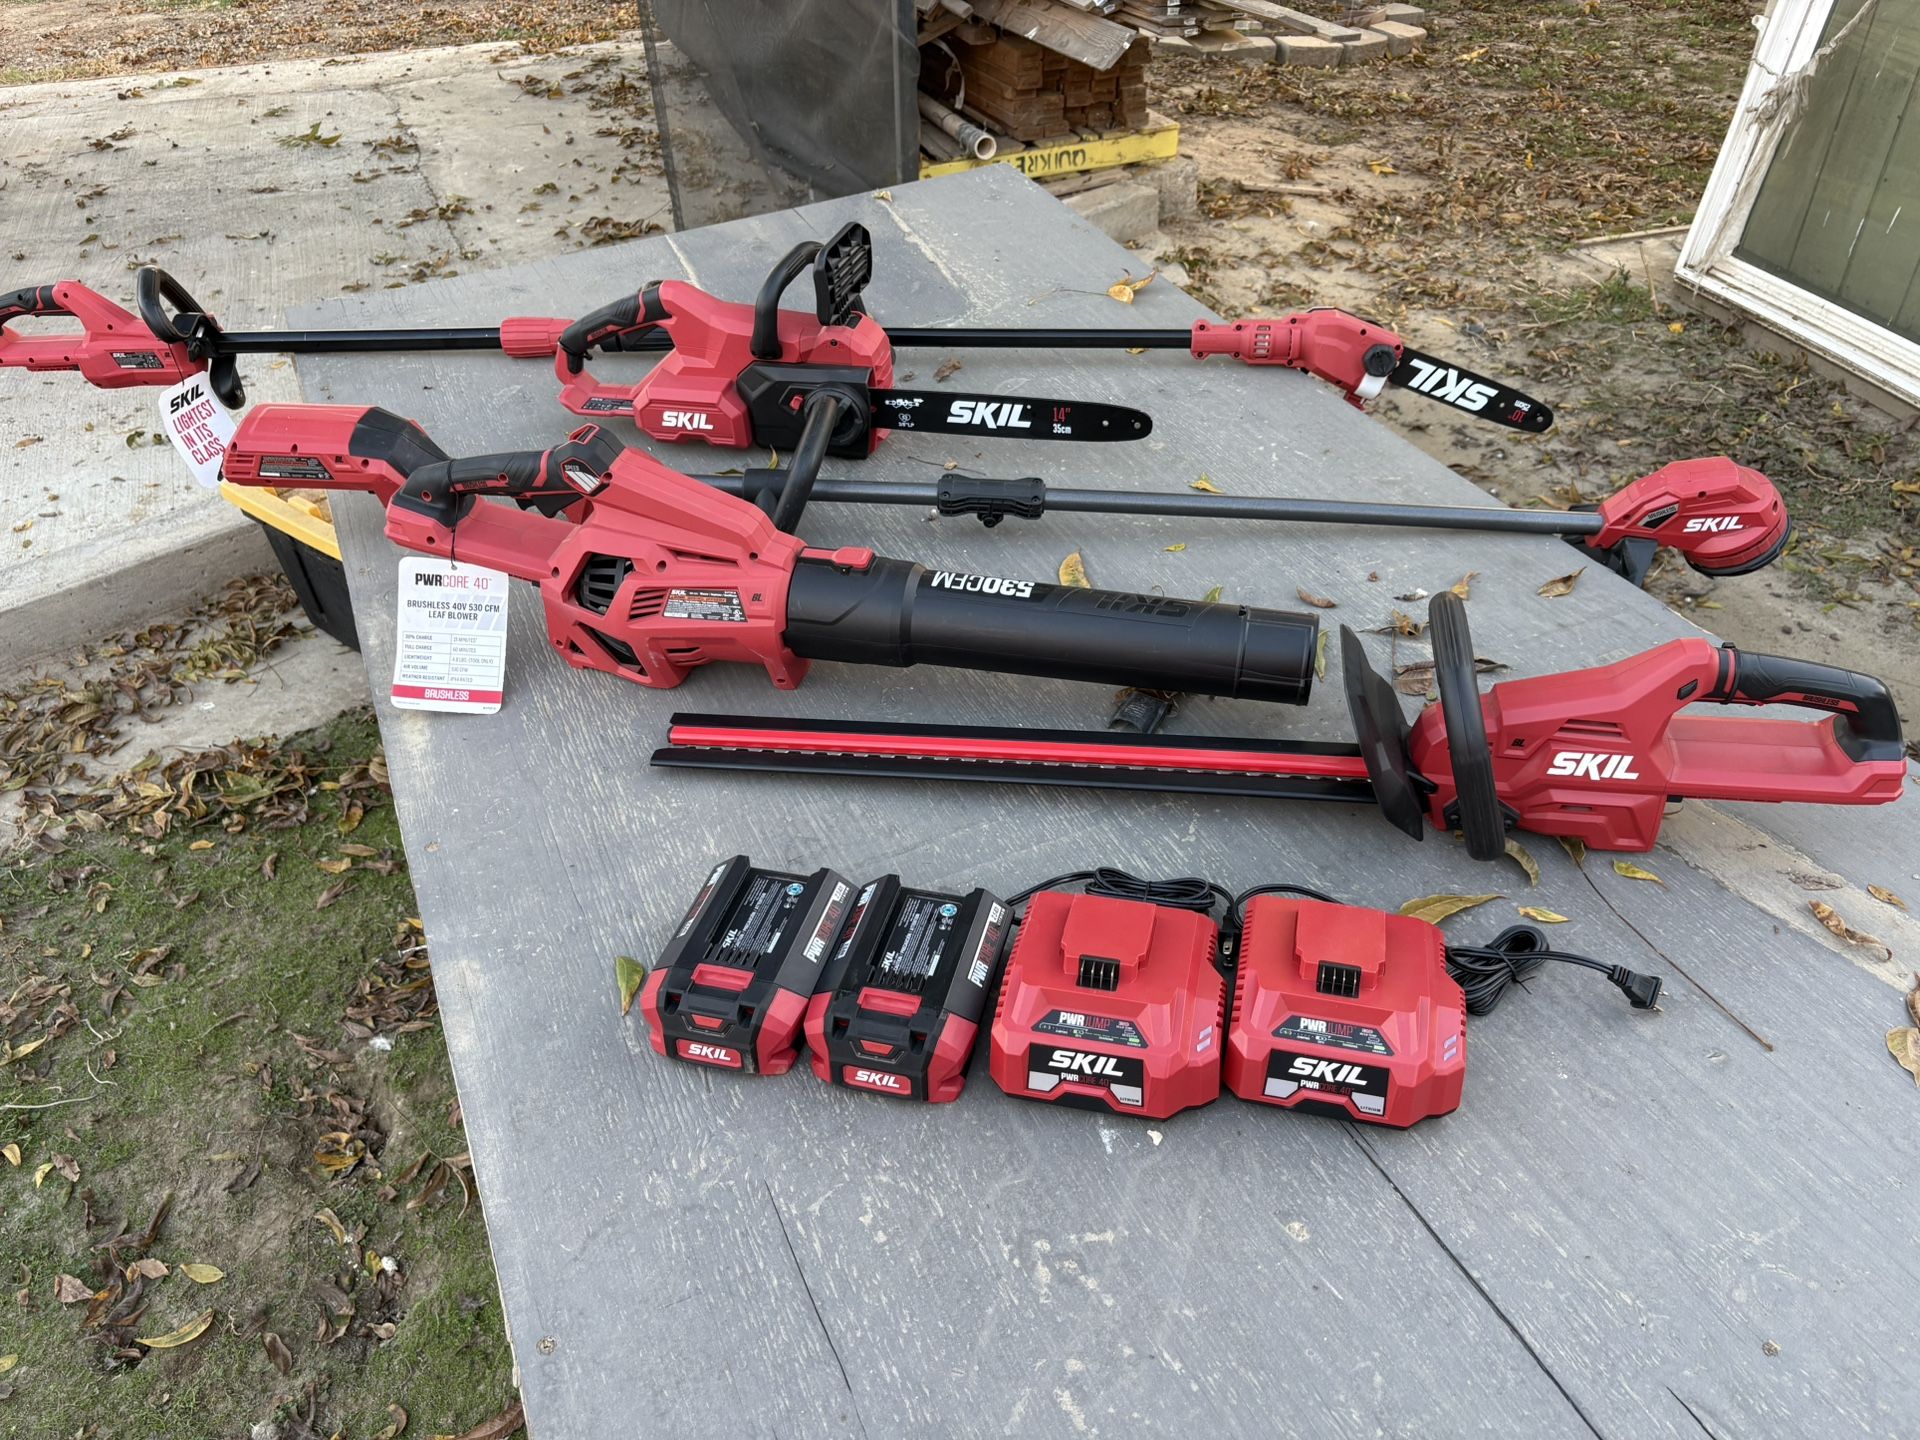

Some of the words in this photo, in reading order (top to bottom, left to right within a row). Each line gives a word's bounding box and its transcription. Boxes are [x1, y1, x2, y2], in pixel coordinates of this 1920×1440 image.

[1015, 149, 1086, 173] QUIKRE
[1408, 358, 1499, 411] SKIL
[170, 384, 204, 414] SKIL
[173, 399, 216, 434] LIGHTEST
[662, 411, 713, 430] SKIL
[946, 400, 1032, 429] SKIL
[181, 431, 197, 450] IN
[193, 422, 214, 443] ITS
[1053, 423, 1071, 434] 35cm
[191, 437, 226, 465] CLASS
[1683, 516, 1743, 533] SKIL
[415, 573, 469, 589] PWRCORE
[474, 577, 489, 590] 40
[407, 600, 450, 610] BRUSHLESS
[452, 602, 467, 611] 40V
[468, 603, 483, 612] 530
[485, 604, 500, 613] CFM
[428, 610, 446, 619] LEAF
[448, 611, 478, 620] BLOWER
[424, 688, 469, 701] BRUSHLESS
[1546, 751, 1639, 780] SKIL
[722, 928, 738, 948] SKIL
[1059, 1012, 1110, 1029] PWRJUMP
[1300, 1017, 1353, 1036] PWRJUMP
[688, 1043, 731, 1061] SKIL
[1048, 1050, 1123, 1077] SKIL
[1288, 1056, 1367, 1086] SKIL
[855, 1070, 899, 1088] SKIL
[1300, 1079, 1337, 1093] PWRCORE
